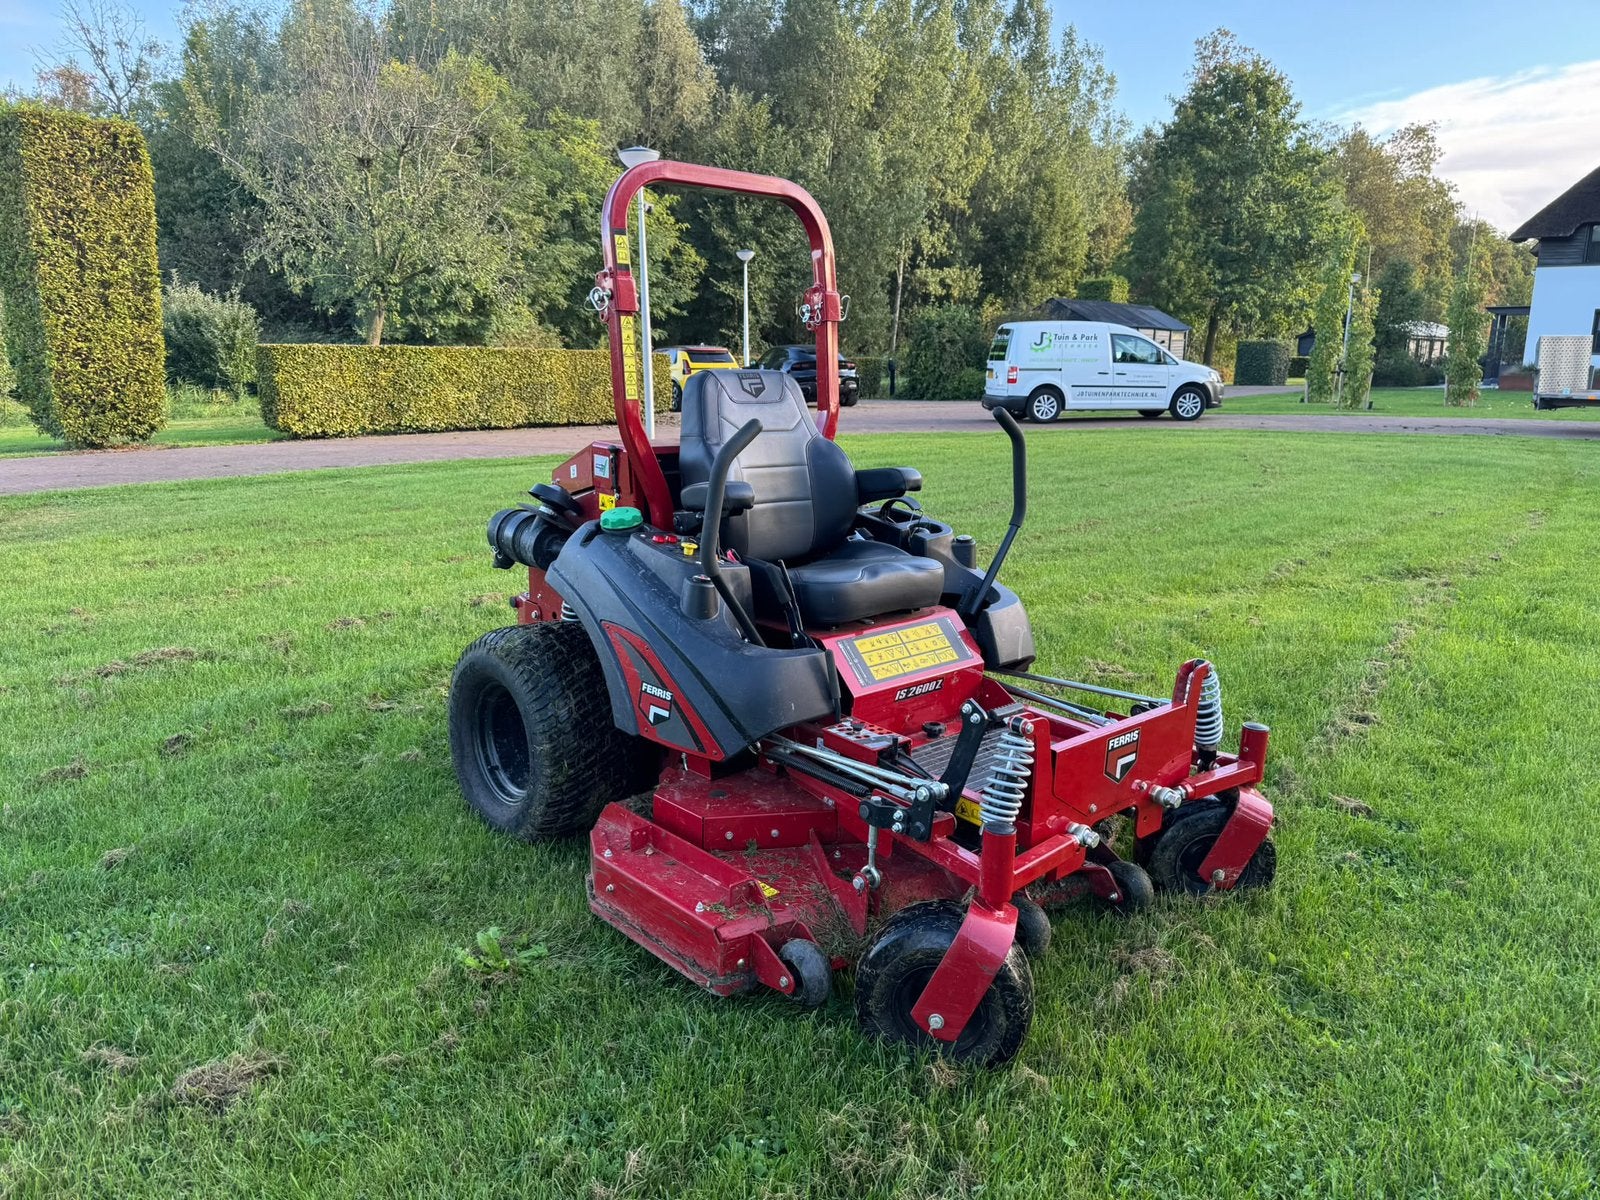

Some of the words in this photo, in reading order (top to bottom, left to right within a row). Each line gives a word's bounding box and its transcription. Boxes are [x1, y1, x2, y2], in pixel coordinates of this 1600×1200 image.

[1053, 333, 1070, 341] Tuin
[1072, 333, 1078, 341] &
[1081, 333, 1099, 341] Park
[642, 682, 673, 701] FERRIS
[895, 688, 908, 701] IS
[907, 679, 944, 697] 2600Z
[1108, 730, 1139, 750] FERRIS
